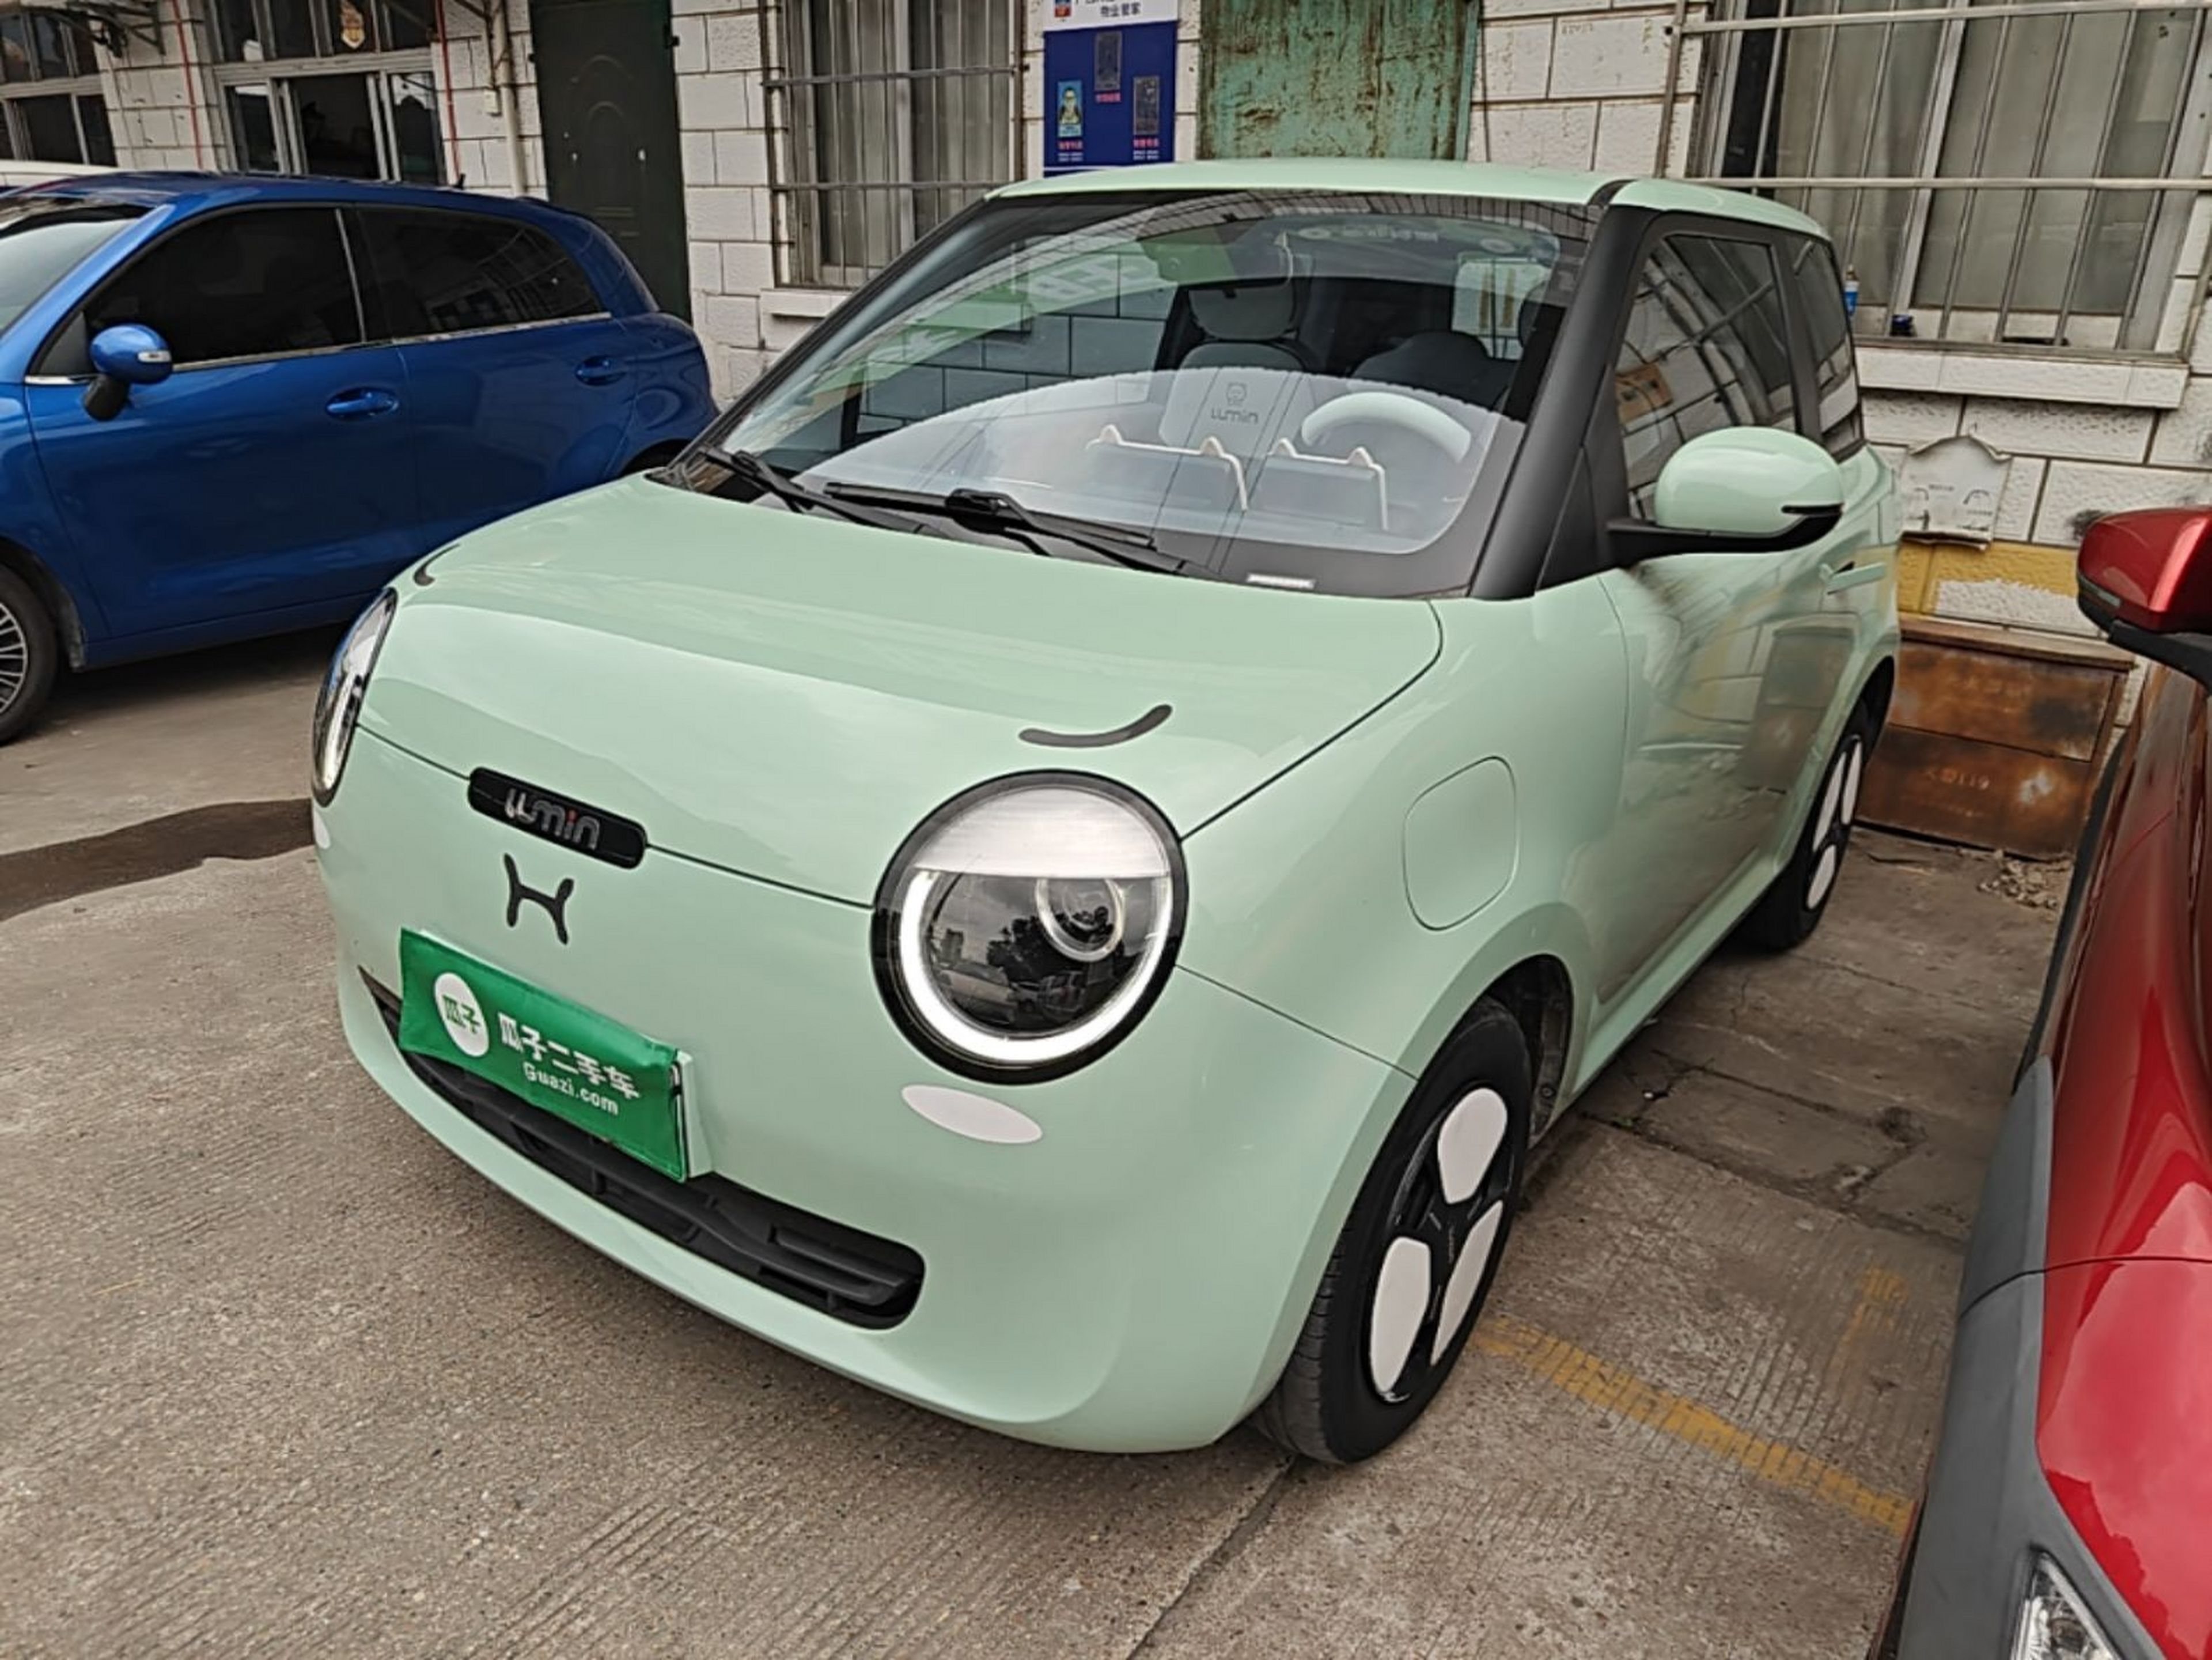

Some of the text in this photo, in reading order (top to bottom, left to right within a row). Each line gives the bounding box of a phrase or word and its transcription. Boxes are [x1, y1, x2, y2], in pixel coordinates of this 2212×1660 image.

[442, 994, 481, 1034] 瓜子
[497, 1012, 640, 1099] 瓜子二手车
[522, 1061, 618, 1116] Guazi.com
